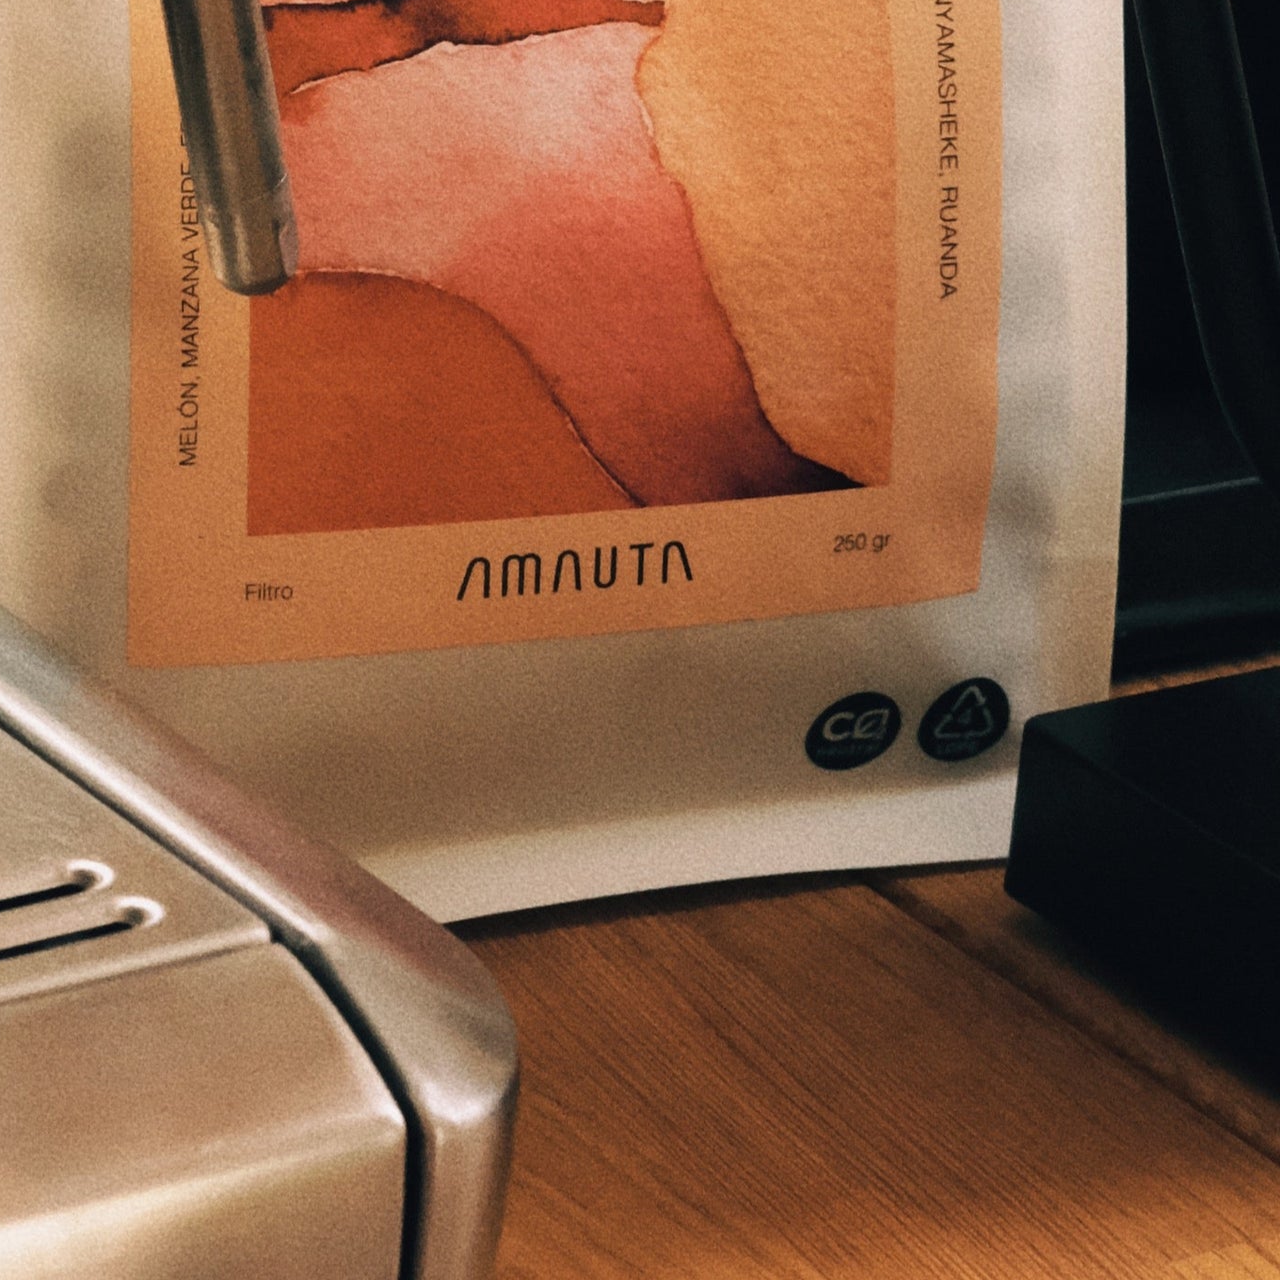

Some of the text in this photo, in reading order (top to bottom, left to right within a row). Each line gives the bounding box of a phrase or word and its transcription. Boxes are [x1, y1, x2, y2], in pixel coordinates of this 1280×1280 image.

[938, 186, 958, 299] RUANDA
[180, 247, 200, 368] MANZANA
[178, 374, 200, 467] MELÓN,
[456, 541, 694, 601] AMAUTA
[872, 534, 891, 553] gr
[244, 583, 294, 602] Filtro
